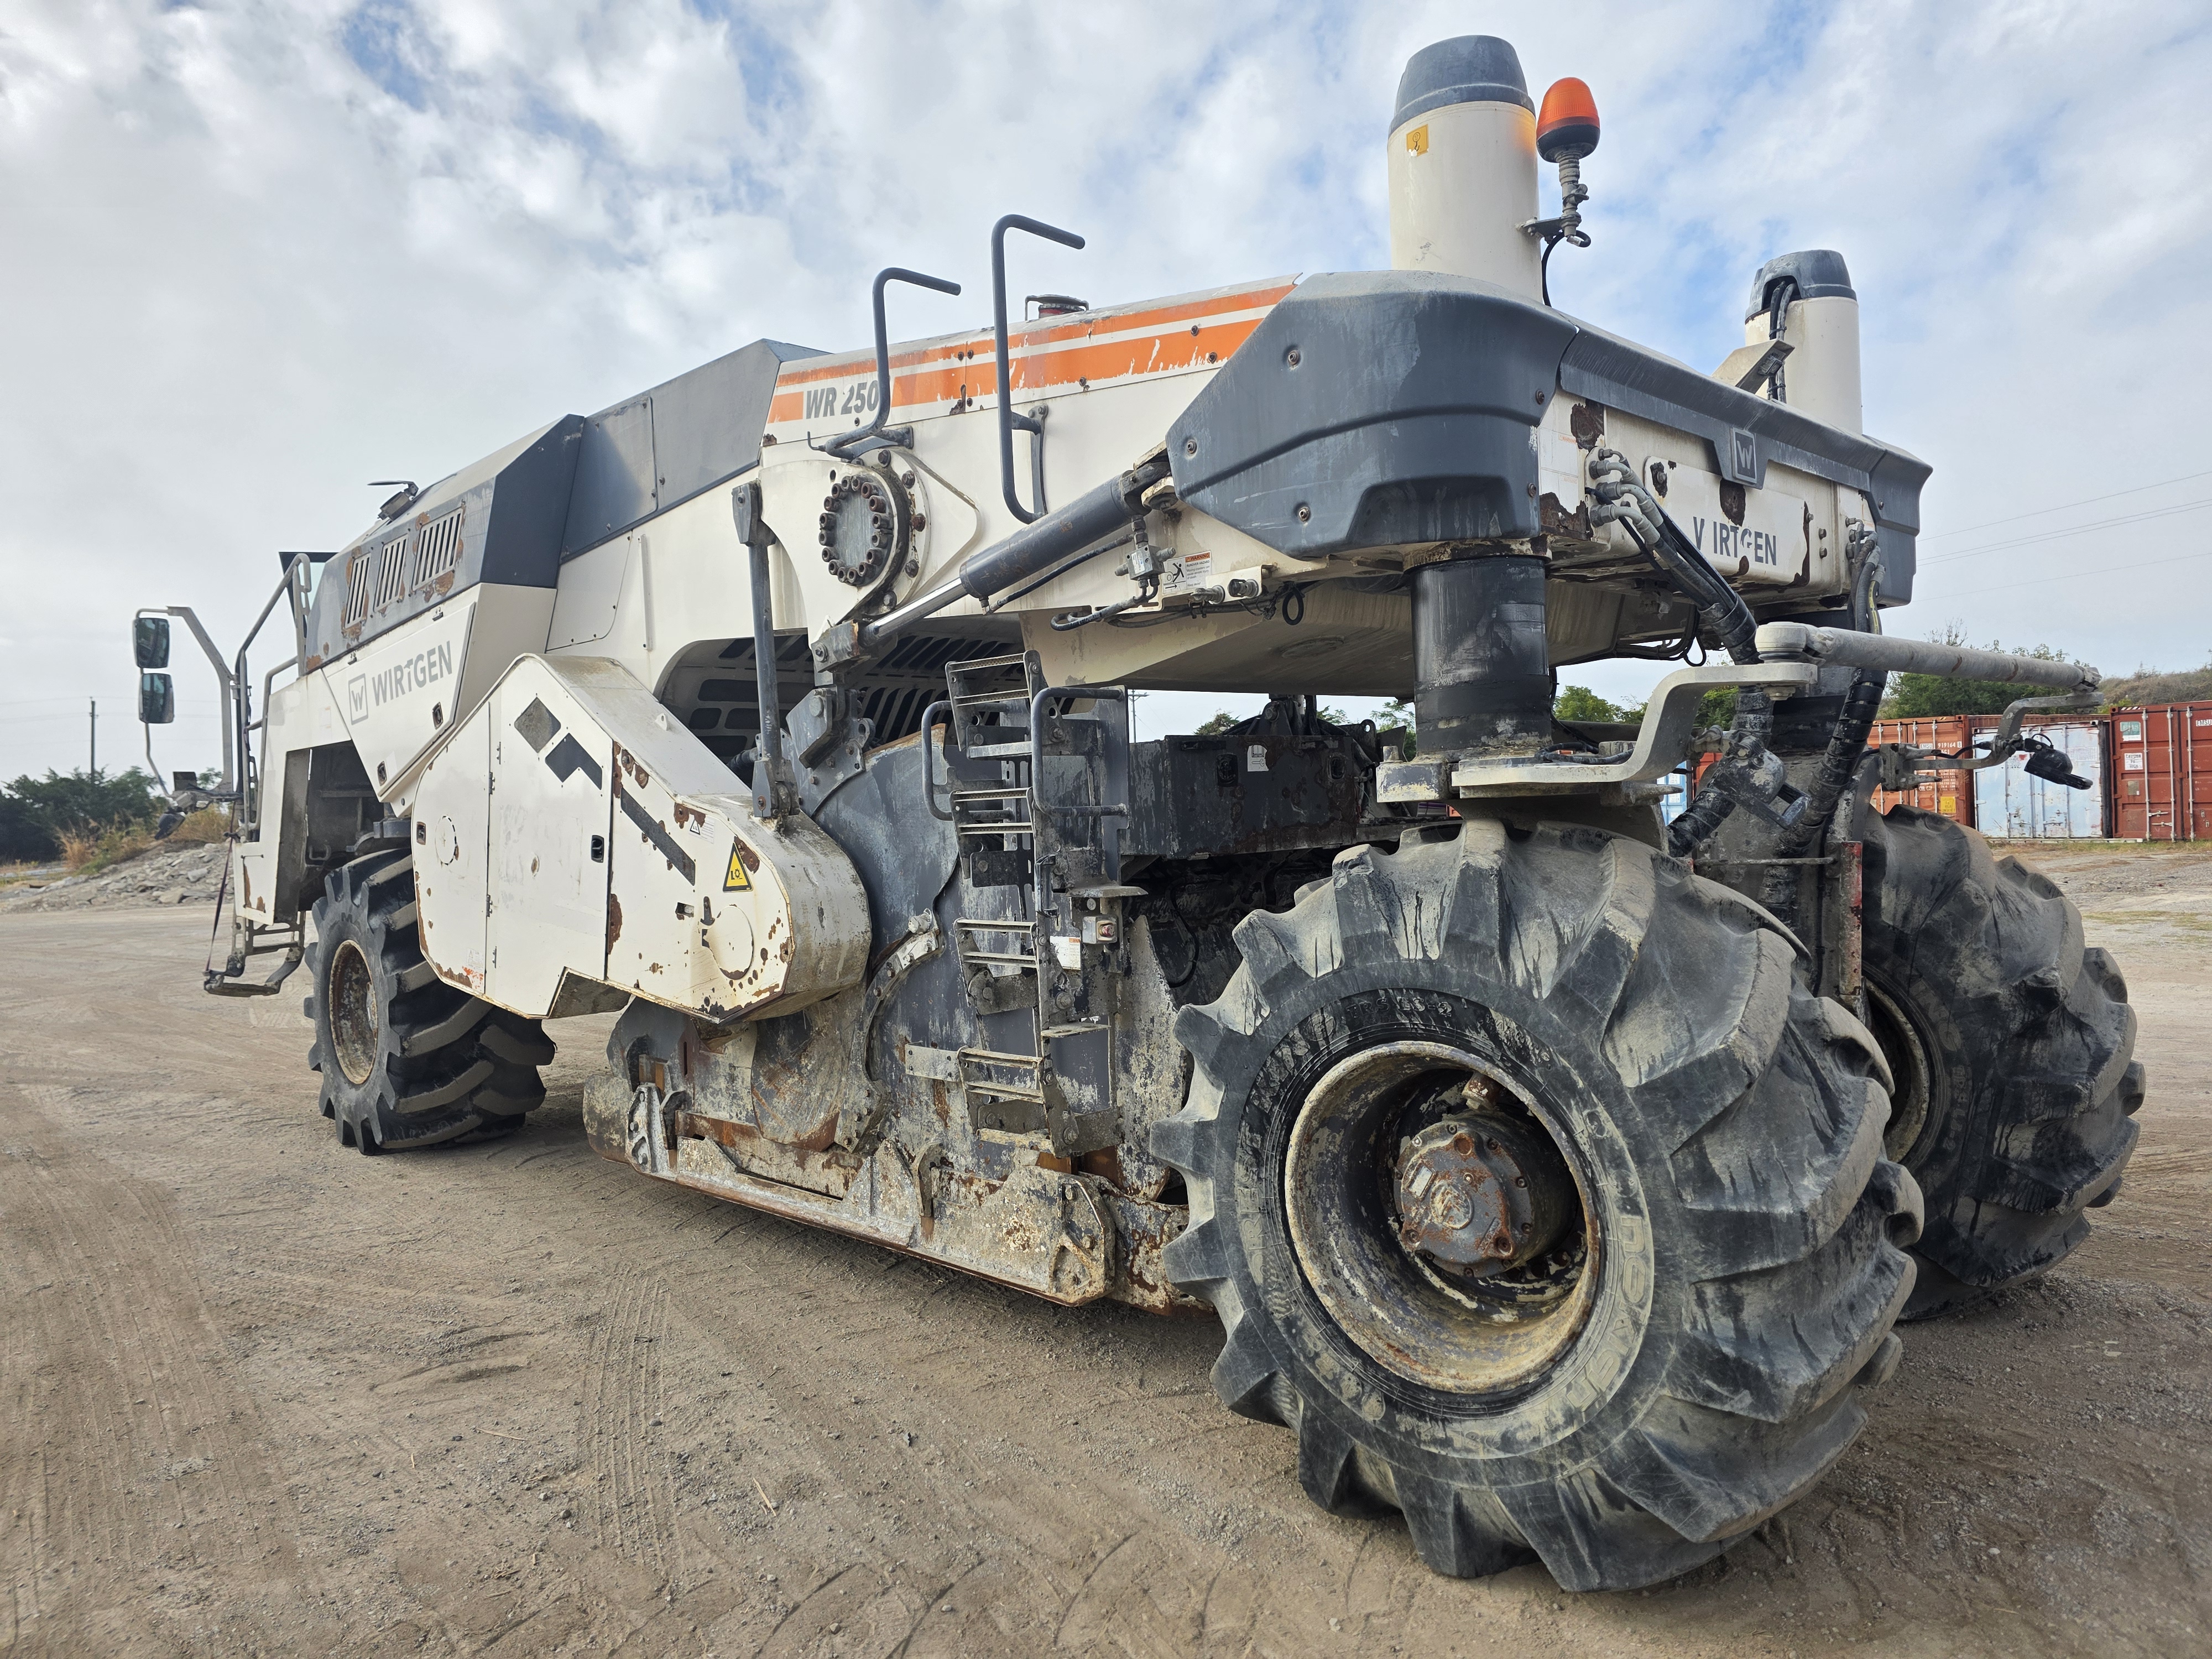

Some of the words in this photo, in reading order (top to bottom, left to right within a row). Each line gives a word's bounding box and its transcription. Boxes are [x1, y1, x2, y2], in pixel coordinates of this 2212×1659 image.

[806, 387, 837, 419] WR
[841, 380, 879, 415] 250
[372, 640, 452, 707] WIRTGEN
